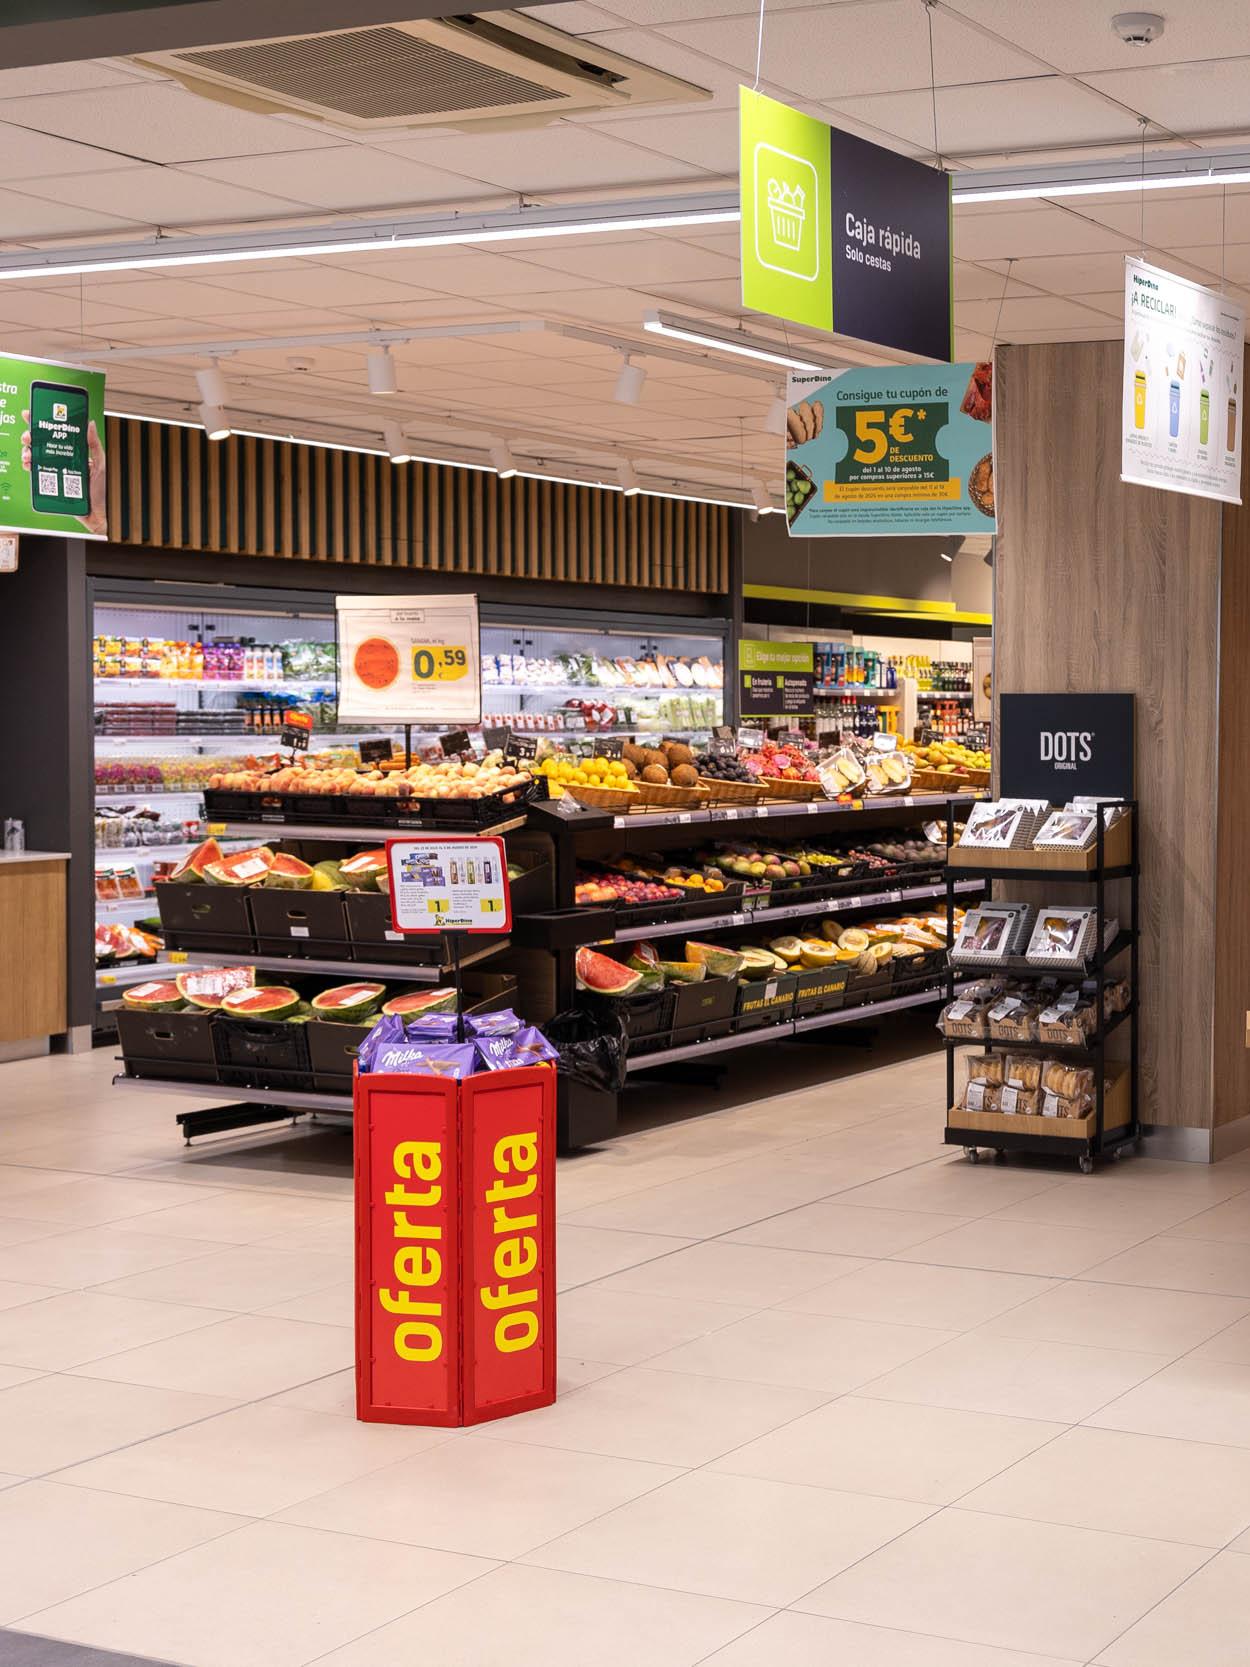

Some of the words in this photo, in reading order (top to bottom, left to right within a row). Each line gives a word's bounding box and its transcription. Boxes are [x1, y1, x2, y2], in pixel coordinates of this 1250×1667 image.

[845, 212, 875, 247] Caja
[879, 225, 921, 259] rápida
[845, 244, 864, 263] Solo
[865, 254, 892, 272] cestas
[1133, 274, 1158, 291] HiperDino
[1141, 294, 1177, 318] RECICLAR!
[791, 375, 832, 384] SuperDino
[836, 389, 883, 402] Consigue
[886, 389, 898, 399] tu
[900, 387, 932, 400] cupón
[935, 386, 949, 398] de
[38, 420, 80, 433] HiperDino
[52, 431, 68, 440] APP
[889, 455, 934, 463] DESCUENTO
[886, 473, 917, 481] superiores
[901, 466, 922, 474] agosto
[1040, 731, 1092, 762] DOTS
[1054, 762, 1077, 770] ORIGINAL
[798, 987, 817, 999] FRUTAS
[823, 981, 845, 993] CANARIO
[743, 998, 764, 1011] FRUTAS
[771, 992, 794, 1005] CANARIO
[951, 1022, 973, 1034] DOTS
[489, 1037, 514, 1057] Milka
[381, 1048, 424, 1067] Milka
[378, 1138, 443, 1363] oferta
[481, 1130, 540, 1354] oferta
